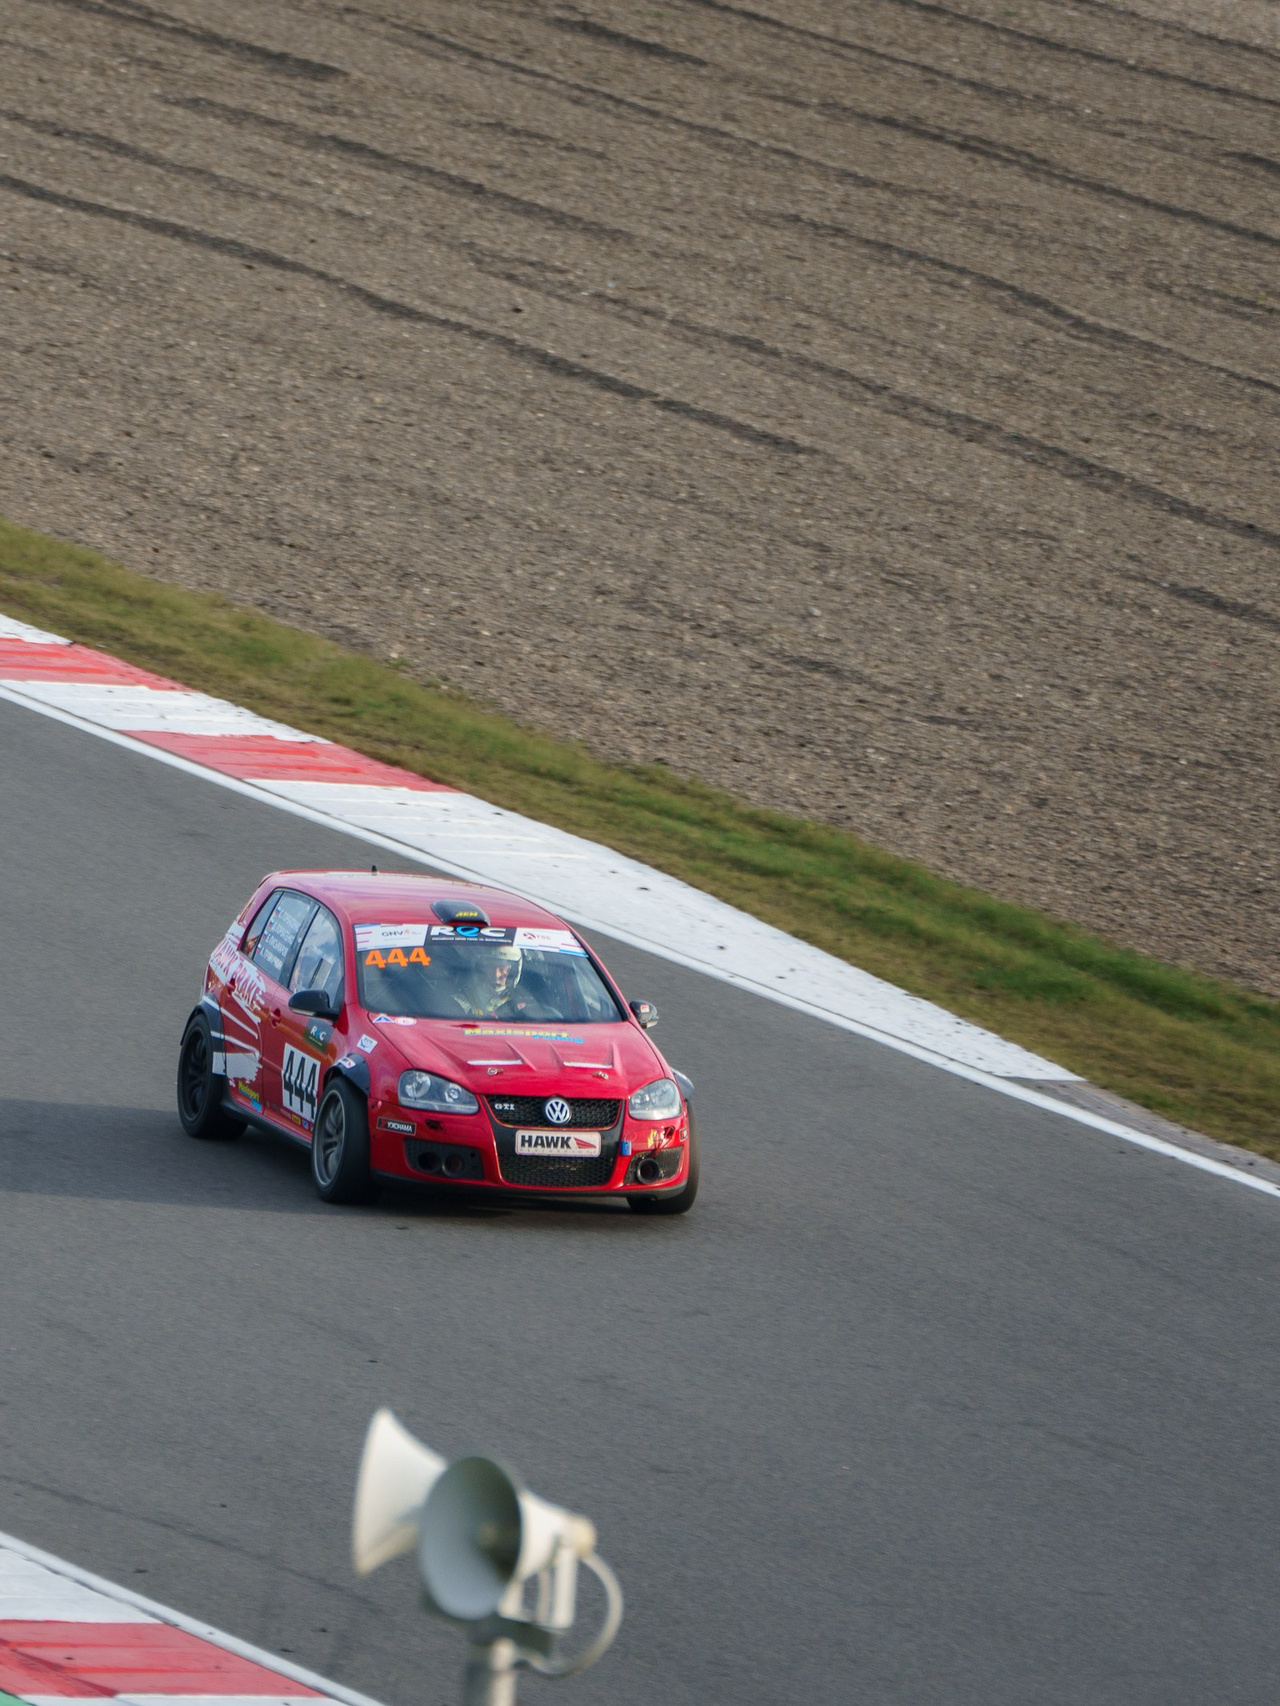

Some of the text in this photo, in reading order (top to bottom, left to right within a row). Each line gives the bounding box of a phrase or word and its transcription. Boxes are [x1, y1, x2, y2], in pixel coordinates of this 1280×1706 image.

[381, 929, 404, 938] GNV
[365, 946, 432, 969] 444
[283, 1050, 318, 1120] 444
[495, 1102, 516, 1111] GTI
[386, 1121, 413, 1133] YOKOHAMA
[520, 1134, 572, 1149] HAWK
